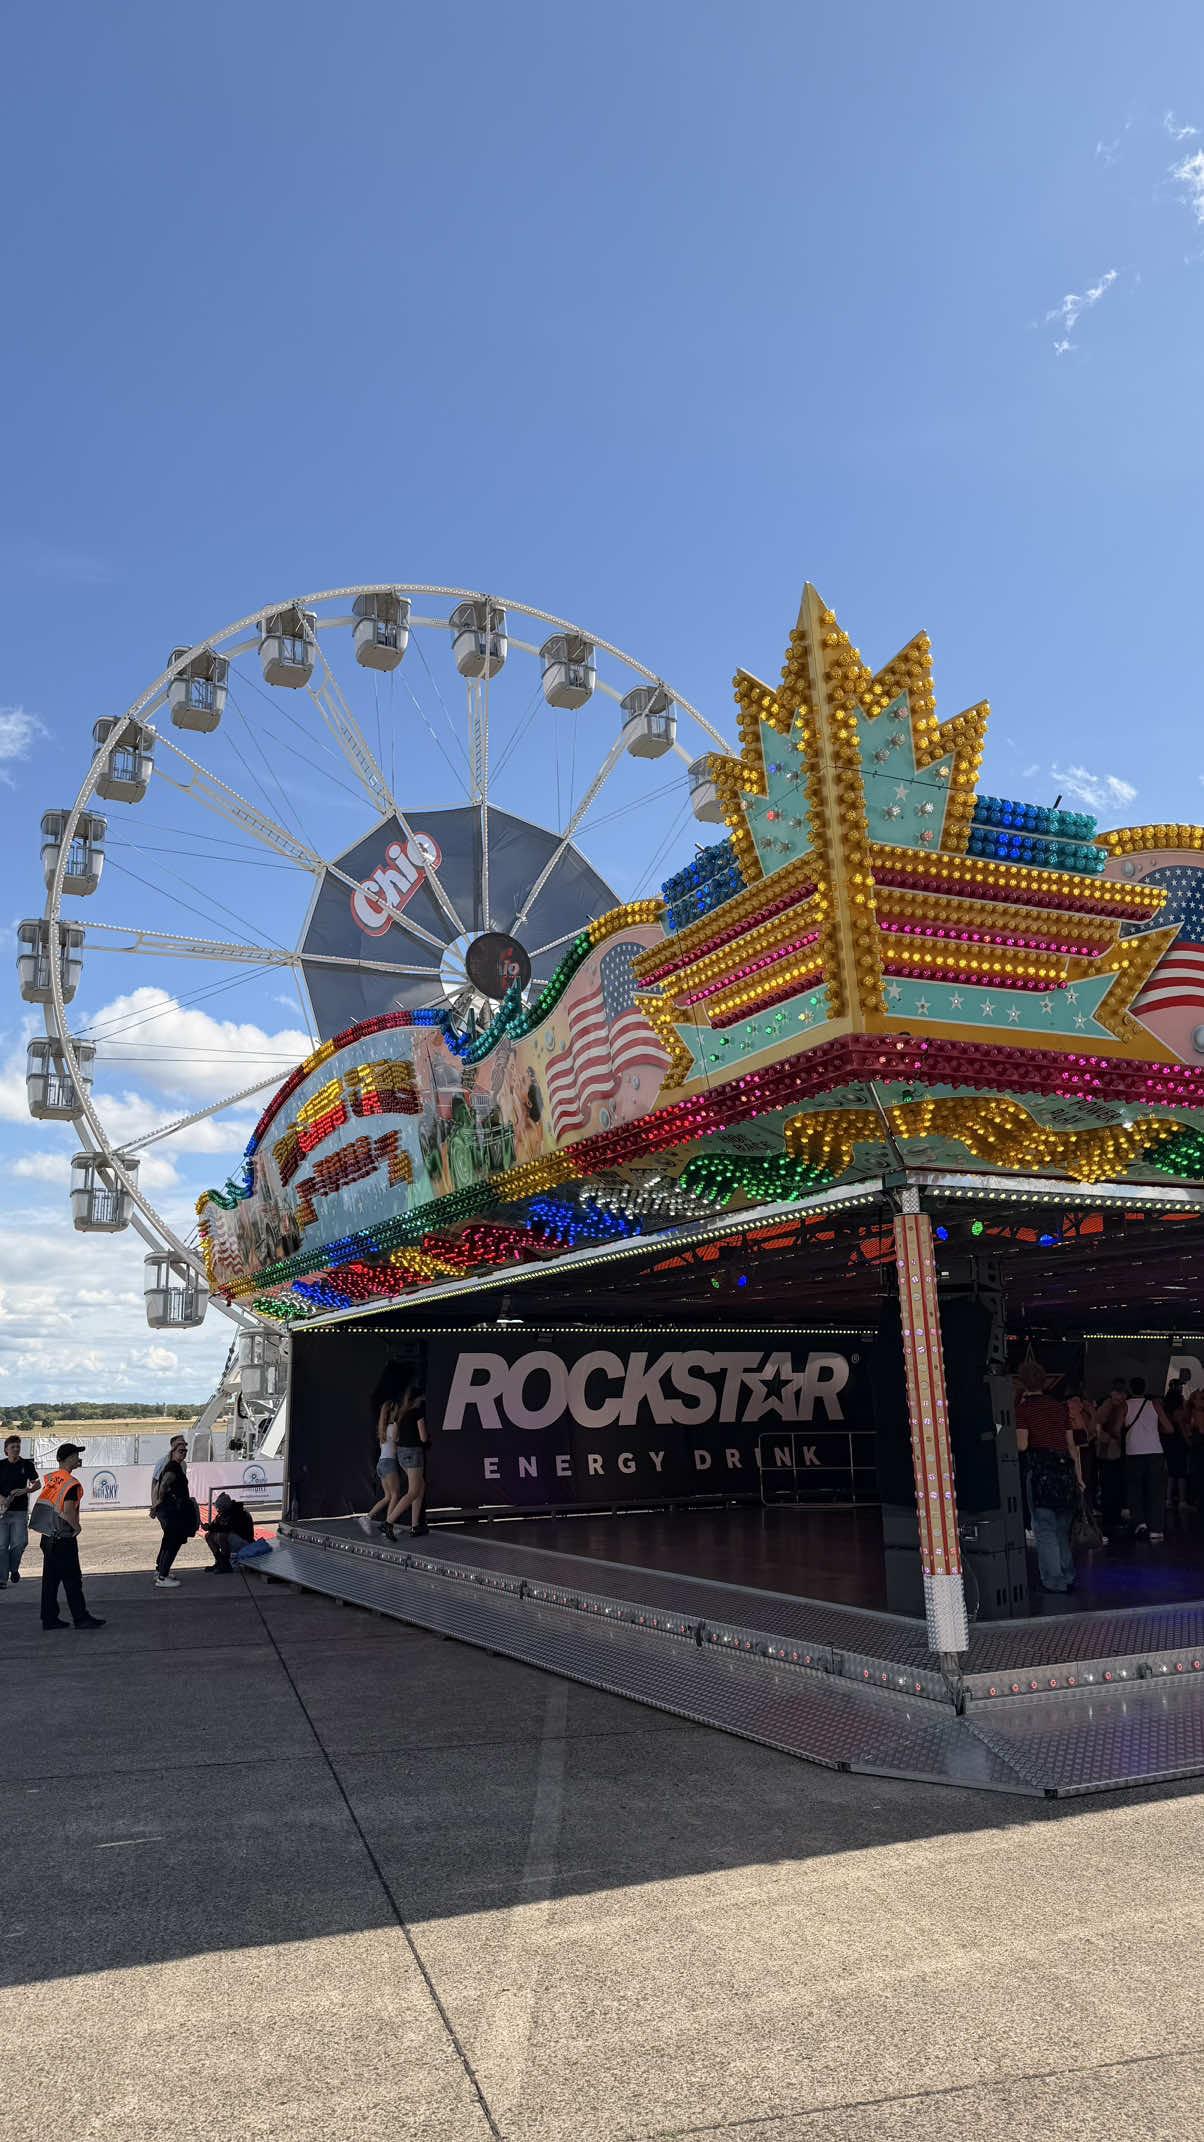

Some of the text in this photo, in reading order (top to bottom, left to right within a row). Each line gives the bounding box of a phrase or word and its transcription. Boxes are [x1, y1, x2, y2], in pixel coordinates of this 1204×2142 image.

[353, 833, 440, 929] Chio
[483, 1445, 822, 1479] ENERGY DRINK
